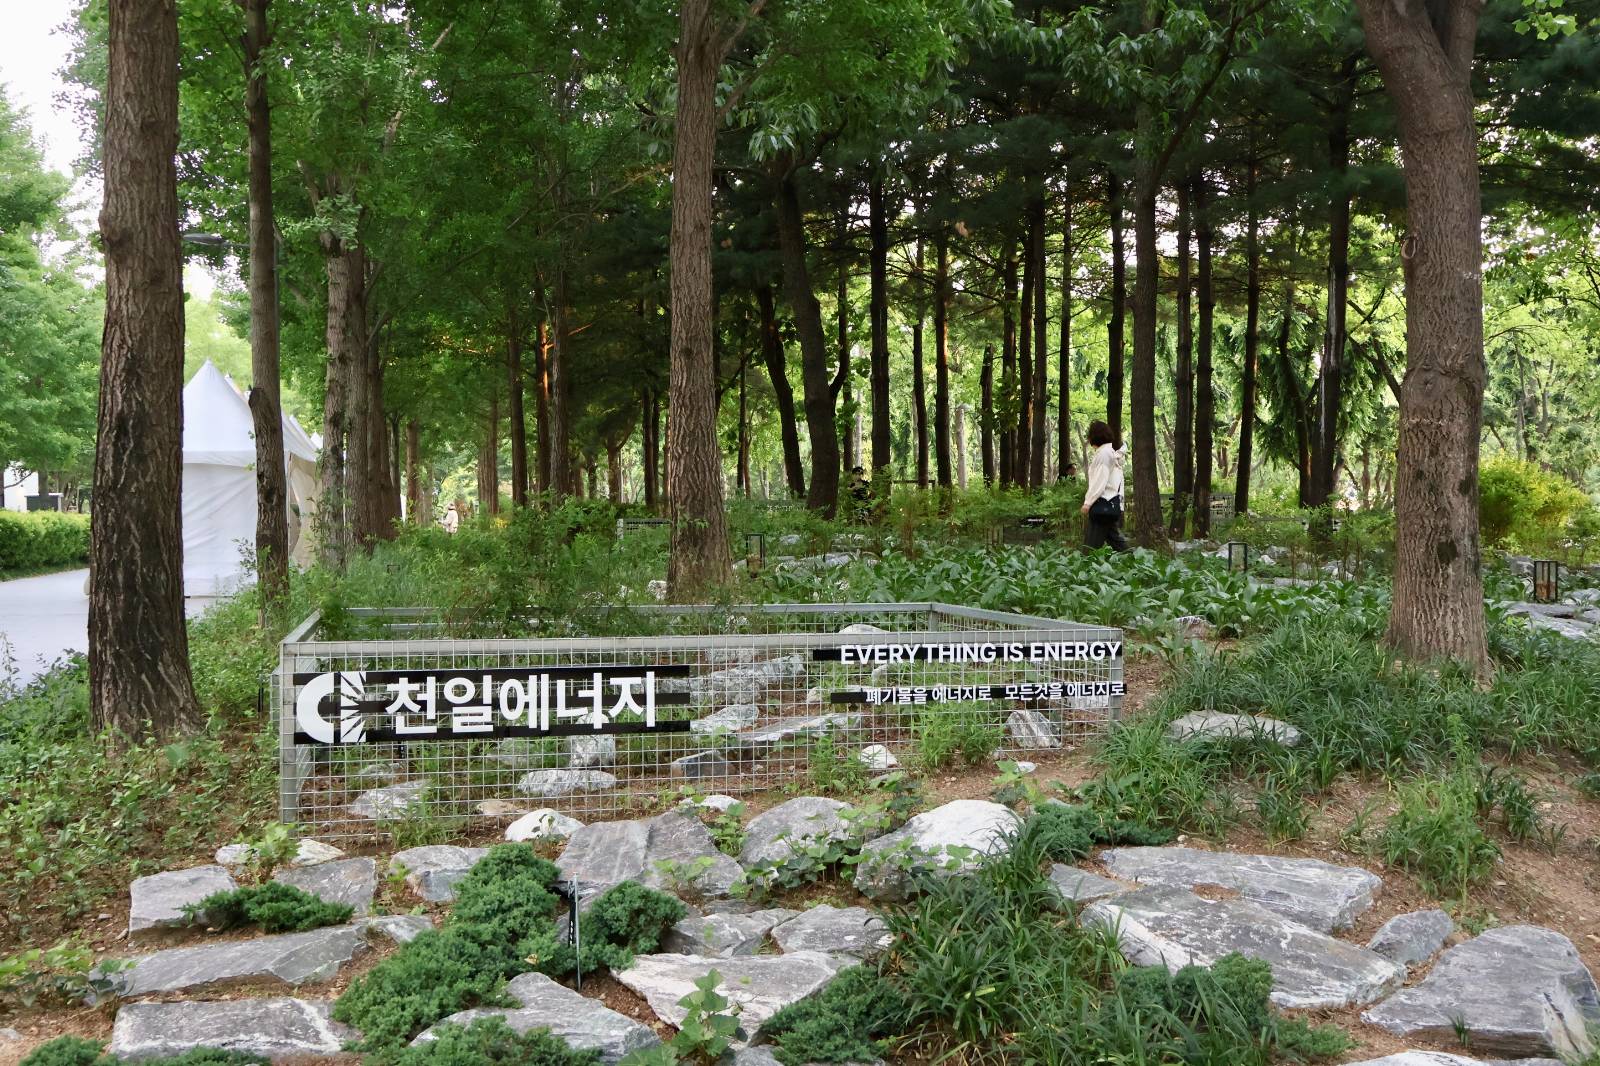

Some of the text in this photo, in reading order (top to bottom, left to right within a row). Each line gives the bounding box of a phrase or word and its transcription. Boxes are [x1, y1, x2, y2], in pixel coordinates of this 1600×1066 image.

[1003, 642, 1024, 662] IS
[1030, 641, 1121, 661] ENERGY
[385, 670, 656, 735] 천일에너지
[865, 680, 1125, 705] 폐기물을 에너지로 모든것을 에너지로
